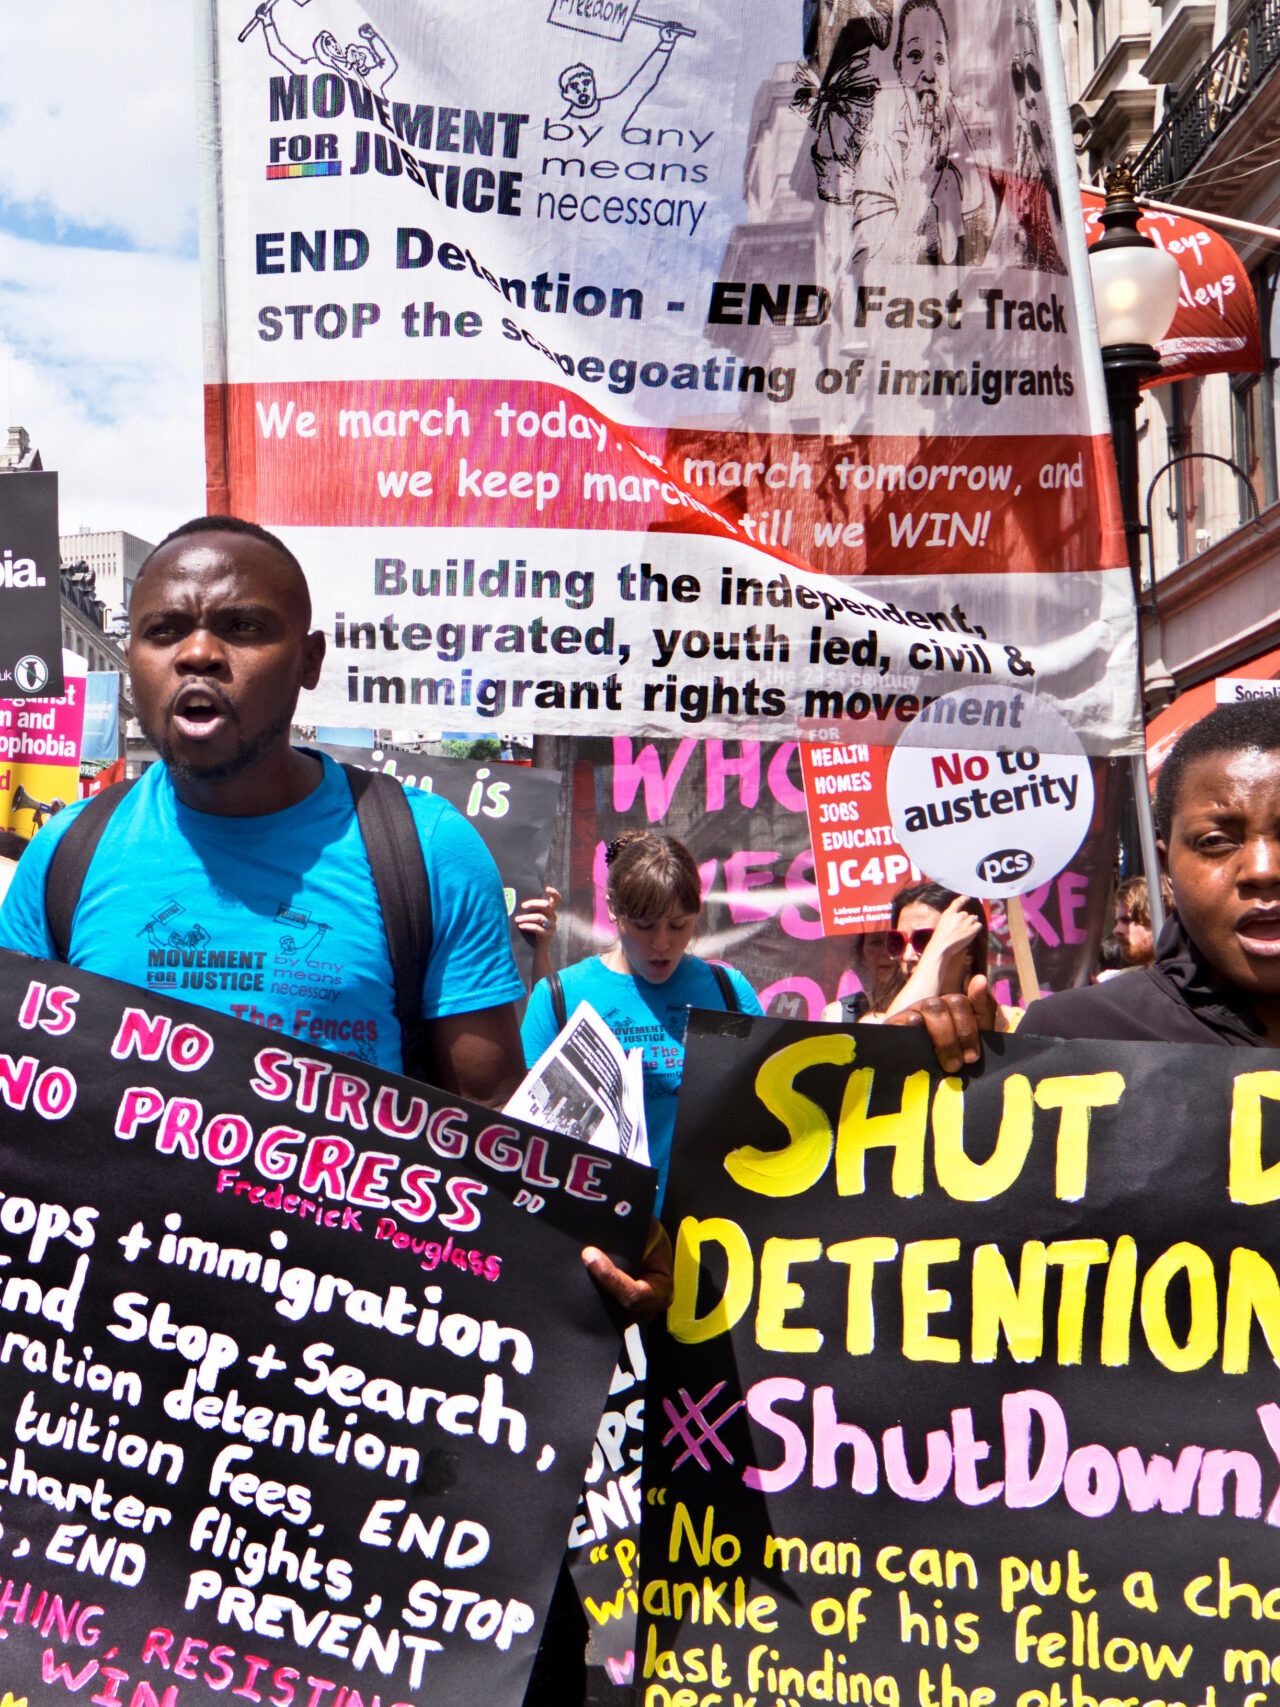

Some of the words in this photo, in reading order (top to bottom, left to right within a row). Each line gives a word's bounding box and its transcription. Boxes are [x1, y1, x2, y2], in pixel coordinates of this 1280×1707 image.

[269, 73, 529, 158] MOVEMENT
[542, 118, 603, 147] by
[622, 125, 715, 152] any
[269, 133, 339, 162] FOR
[350, 130, 522, 216] JUSTICE
[541, 154, 708, 183] means
[537, 188, 706, 236] necessary
[255, 228, 370, 275] END
[396, 226, 643, 320] Detention
[707, 282, 831, 326] END
[854, 287, 962, 333] Fast
[978, 289, 1068, 334] Track
[258, 302, 380, 341] STOP
[401, 302, 483, 338] the
[815, 358, 863, 395] of
[878, 360, 1074, 404] immigrants
[1176, 341, 1209, 350] LONDON
[256, 402, 316, 439] We
[338, 397, 470, 439] march
[683, 453, 812, 491] march
[836, 456, 1022, 497] tomorrow,
[1038, 452, 1083, 490] and
[377, 470, 433, 498] we
[458, 458, 560, 510] keep
[583, 471, 736, 534] marching
[737, 509, 792, 548] till
[814, 518, 866, 547] we
[888, 510, 991, 548] WIN!
[373, 558, 595, 610] Building
[616, 563, 700, 603] the
[720, 566, 988, 640] independent,
[334, 612, 631, 666] integrated,
[651, 624, 790, 668] youth
[809, 626, 890, 676] led,
[908, 638, 990, 674] civil
[1007, 644, 1036, 678] &
[347, 666, 622, 717] immigrant
[643, 674, 786, 724] rights
[804, 690, 1024, 728] movement
[17, 709, 55, 730] and
[812, 744, 870, 767] HEALTH
[931, 753, 989, 788] No
[996, 746, 1040, 775] to
[467, 768, 510, 818] is
[815, 772, 872, 794] HOMES
[904, 774, 1078, 832] austerity
[819, 801, 860, 822] JOBS
[983, 852, 1030, 882] pcs
[834, 906, 860, 916] Labour
[834, 915, 864, 926] Against
[147, 971, 176, 982] FOR
[180, 972, 264, 991] JUSTICE
[148, 950, 268, 970] MOVEMENT
[273, 969, 342, 985] means
[274, 954, 300, 967] by
[306, 959, 344, 973] any
[270, 982, 342, 1002] necessary
[293, 1010, 378, 1042] Fences
[623, 1034, 665, 1042] JUSTICE
[18, 980, 80, 1036] IS
[110, 1006, 214, 1072] NO
[250, 1046, 632, 1216] STRUGGLE.
[724, 1033, 1126, 1202] SHUT
[216, 1170, 362, 1234] Frederick
[374, 1218, 502, 1282] Douglass
[764, 1535, 862, 1578] man
[876, 1546, 978, 1590] can
[1000, 1549, 1097, 1613] put
[1122, 1571, 1158, 1613] a
[643, 1576, 778, 1633] ankle
[810, 1587, 872, 1642] of
[899, 1590, 980, 1654] his
[1016, 1604, 1193, 1681] fellow
